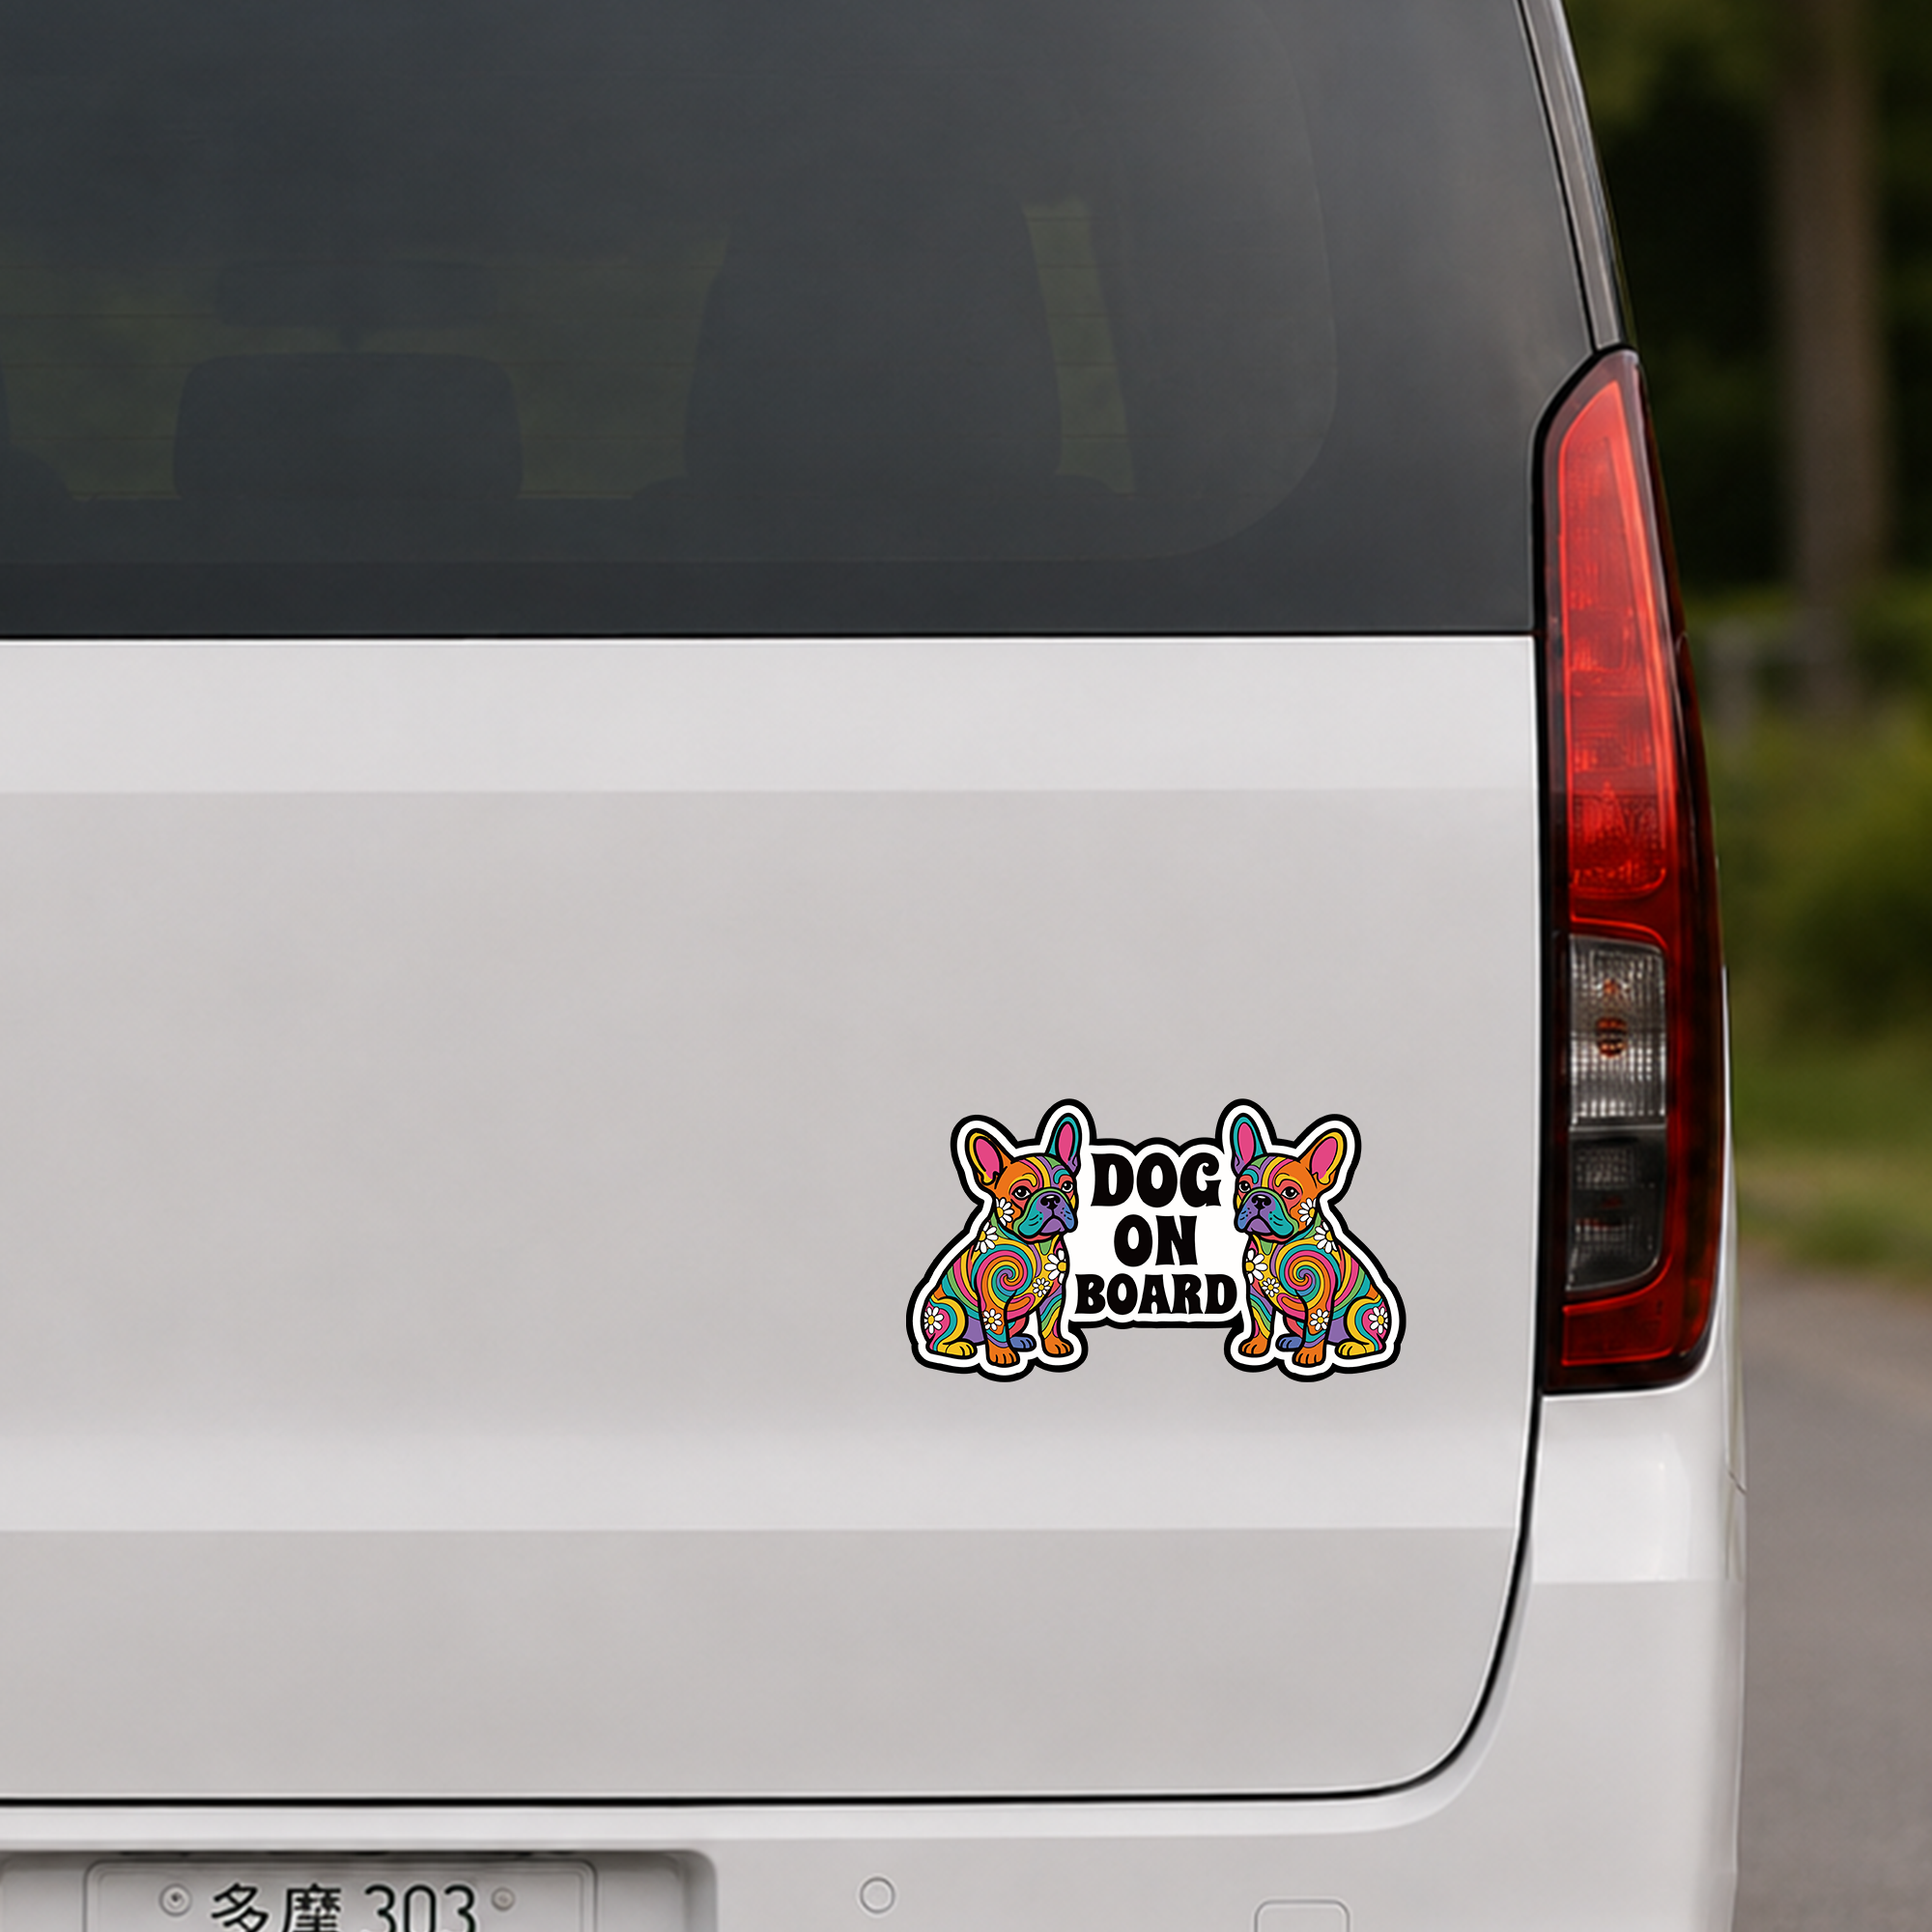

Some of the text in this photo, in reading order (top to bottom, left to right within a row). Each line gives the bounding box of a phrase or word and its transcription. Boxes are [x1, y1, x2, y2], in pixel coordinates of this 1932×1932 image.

[1091, 1152, 1222, 1208] DOG
[1114, 1214, 1198, 1267] ON
[1074, 1273, 1237, 1316] BOARD
[212, 1883, 475, 1932] 多摩 303
